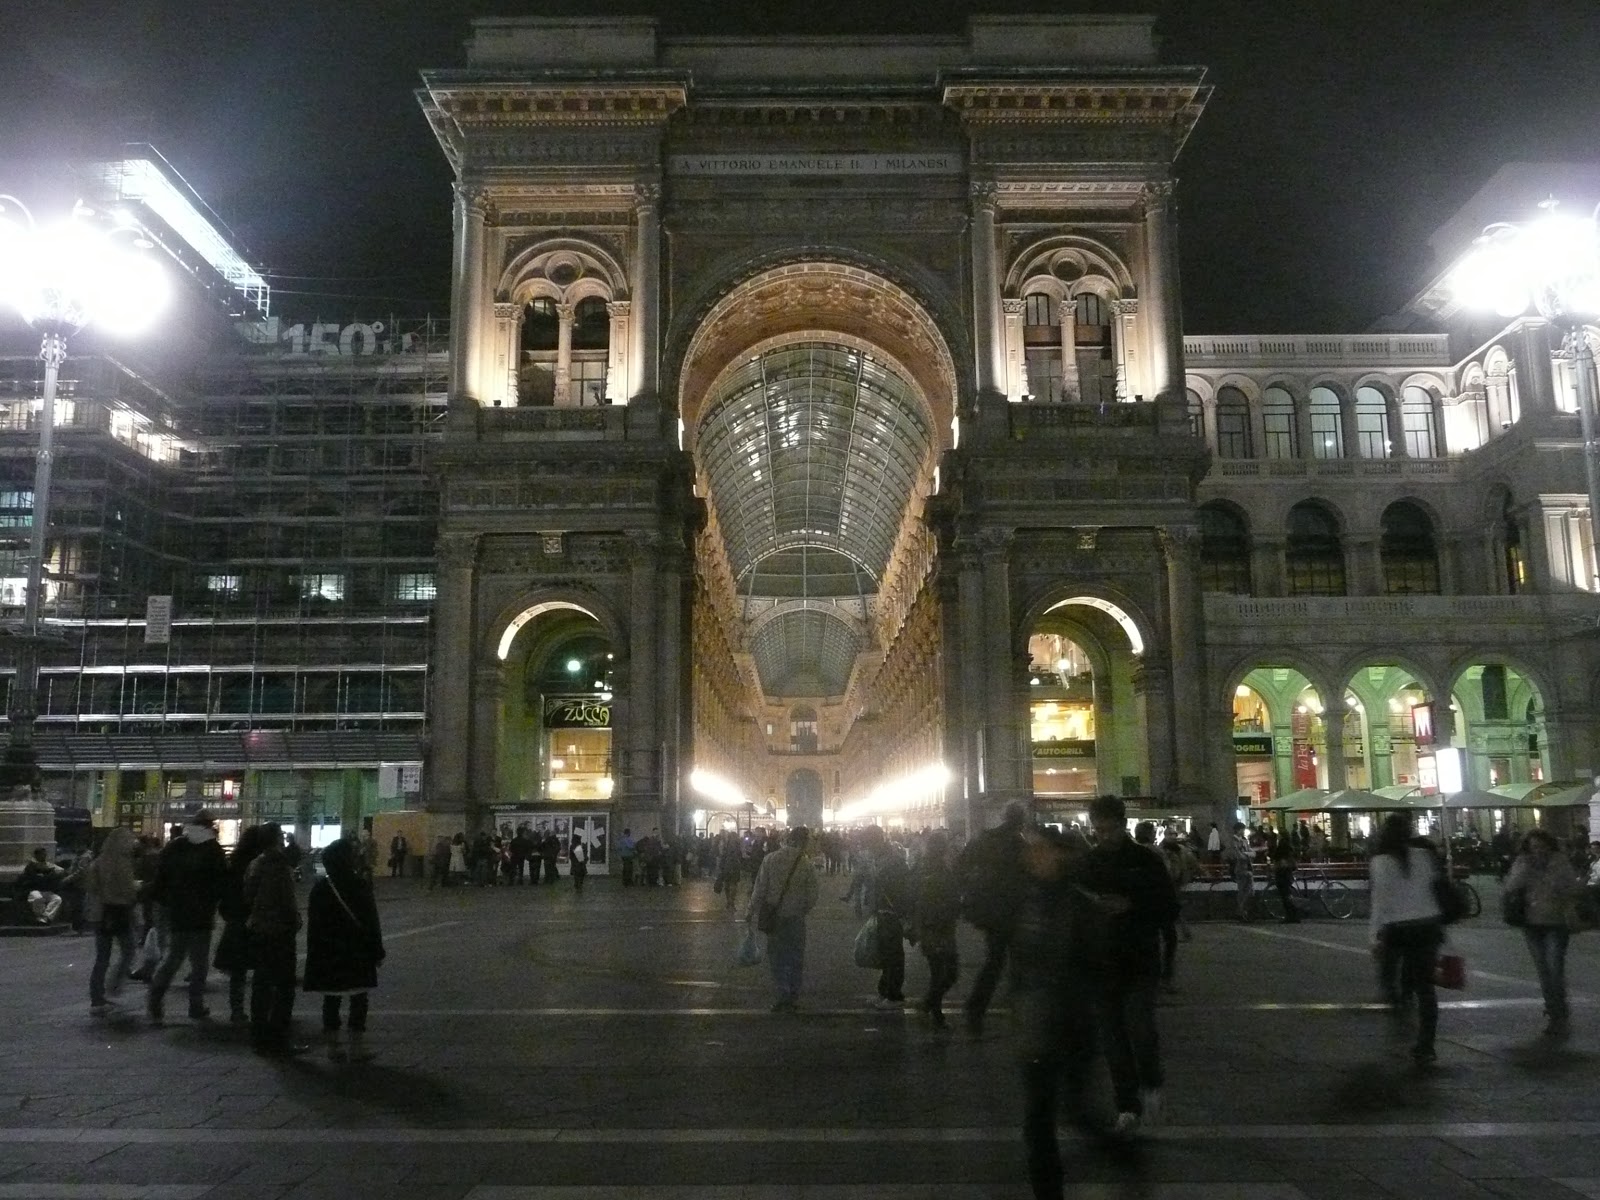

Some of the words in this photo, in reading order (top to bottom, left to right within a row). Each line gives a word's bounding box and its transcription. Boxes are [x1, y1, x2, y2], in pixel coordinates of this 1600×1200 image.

[682, 160, 691, 170] A
[699, 159, 761, 170] VITTORIO
[769, 159, 843, 169] EMANUELE
[886, 158, 948, 169] MILANESI
[1413, 706, 1432, 737] M
